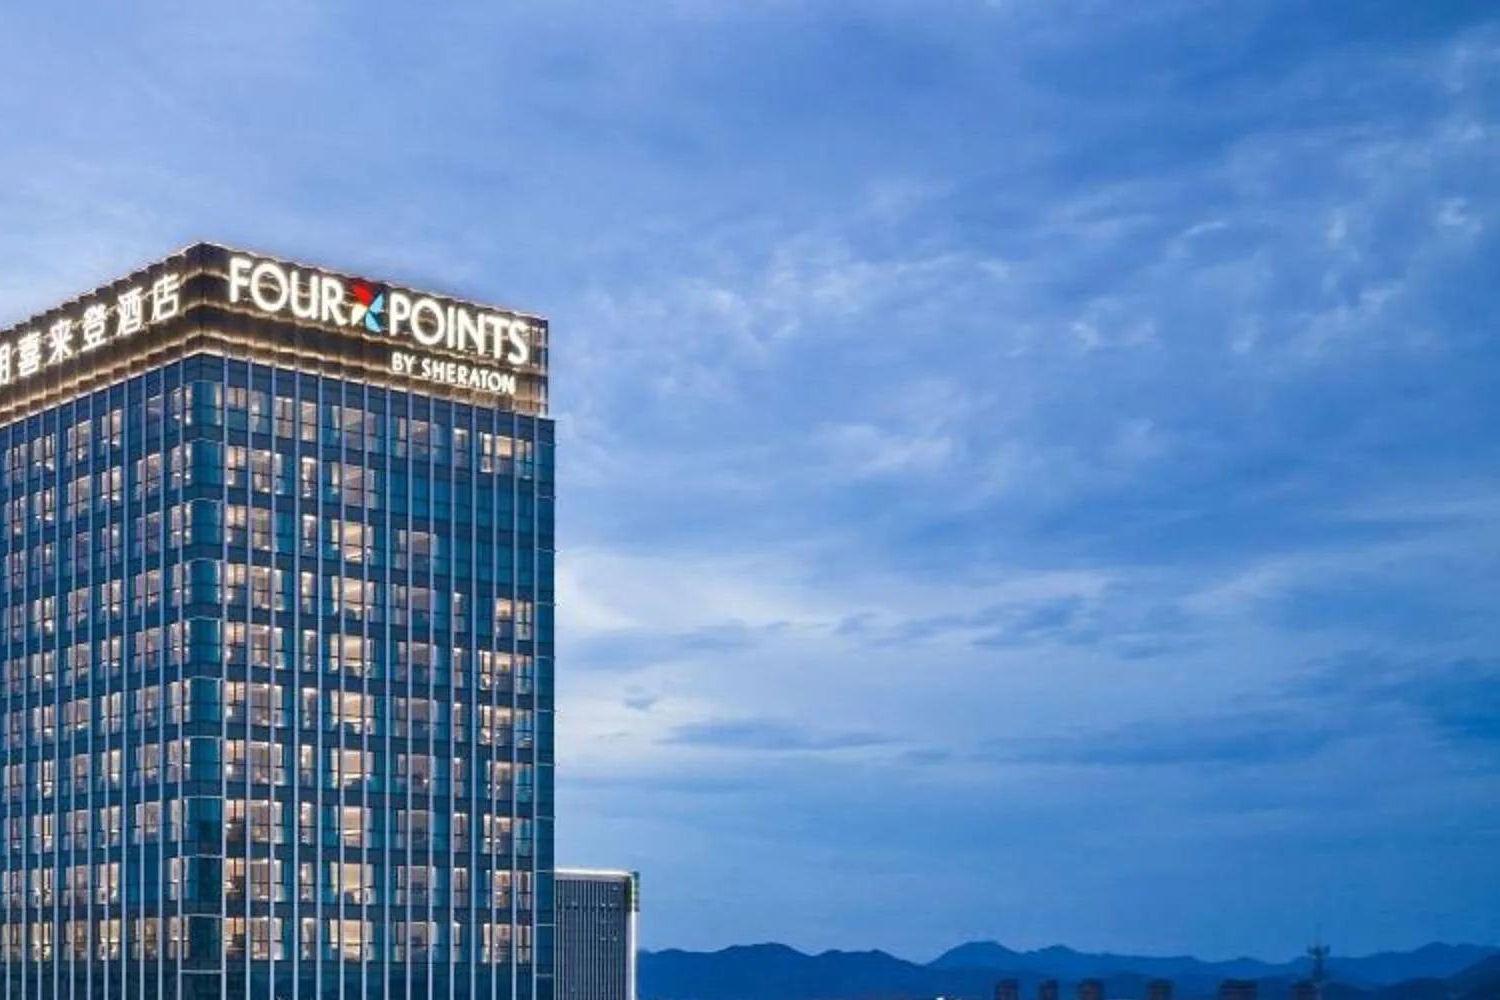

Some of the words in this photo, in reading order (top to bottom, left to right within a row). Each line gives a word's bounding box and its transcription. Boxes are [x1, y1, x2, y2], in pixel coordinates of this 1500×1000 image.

[228, 256, 348, 327] FOUR
[388, 291, 529, 365] POINTS
[391, 352, 416, 374] BY
[421, 356, 516, 395] SHERATON
